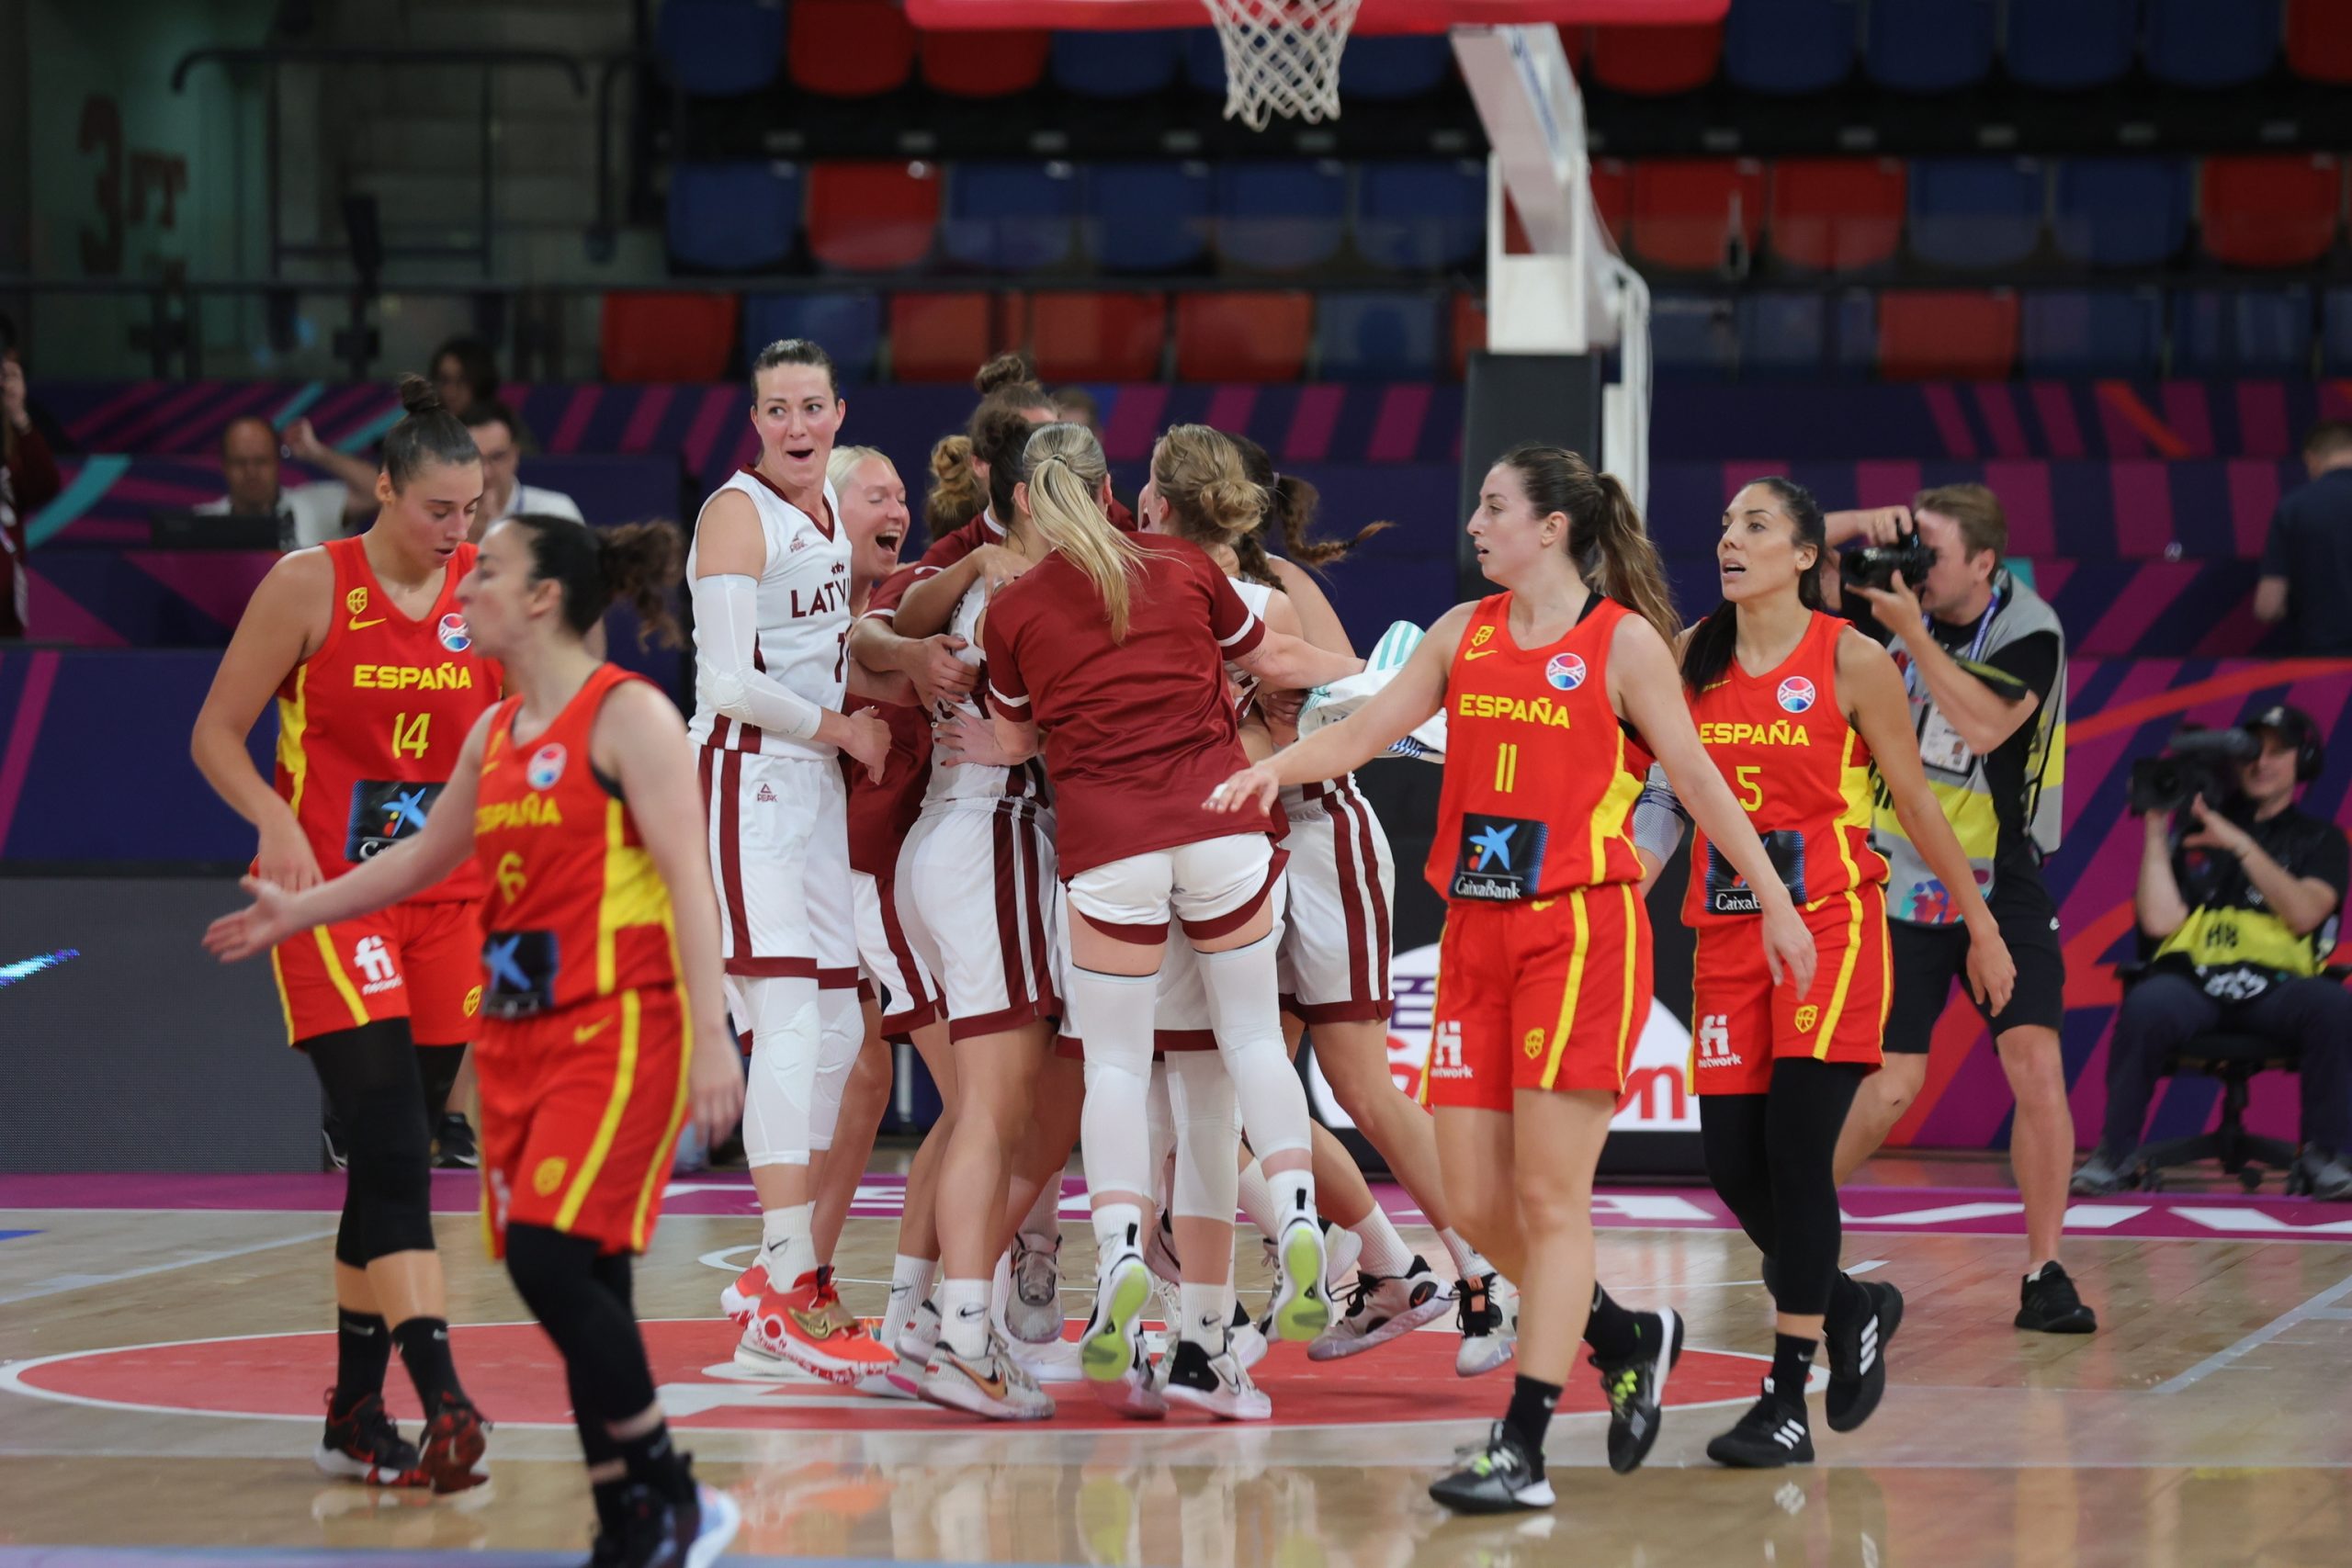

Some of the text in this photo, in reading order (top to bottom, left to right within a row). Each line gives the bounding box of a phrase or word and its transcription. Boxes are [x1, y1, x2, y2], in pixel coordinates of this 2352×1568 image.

[791, 578, 850, 618] LATVI
[353, 662, 472, 690] ESPAÑA
[1458, 694, 1570, 729] ESPAÑA
[391, 712, 432, 760] 14
[1699, 720, 1810, 746] ESPAÑA
[1494, 743, 1518, 793] 11
[1736, 766, 1763, 812] 5
[497, 851, 526, 904] 6
[1454, 875, 1521, 899] CaixaBank
[1715, 893, 1762, 910] CaixaB
